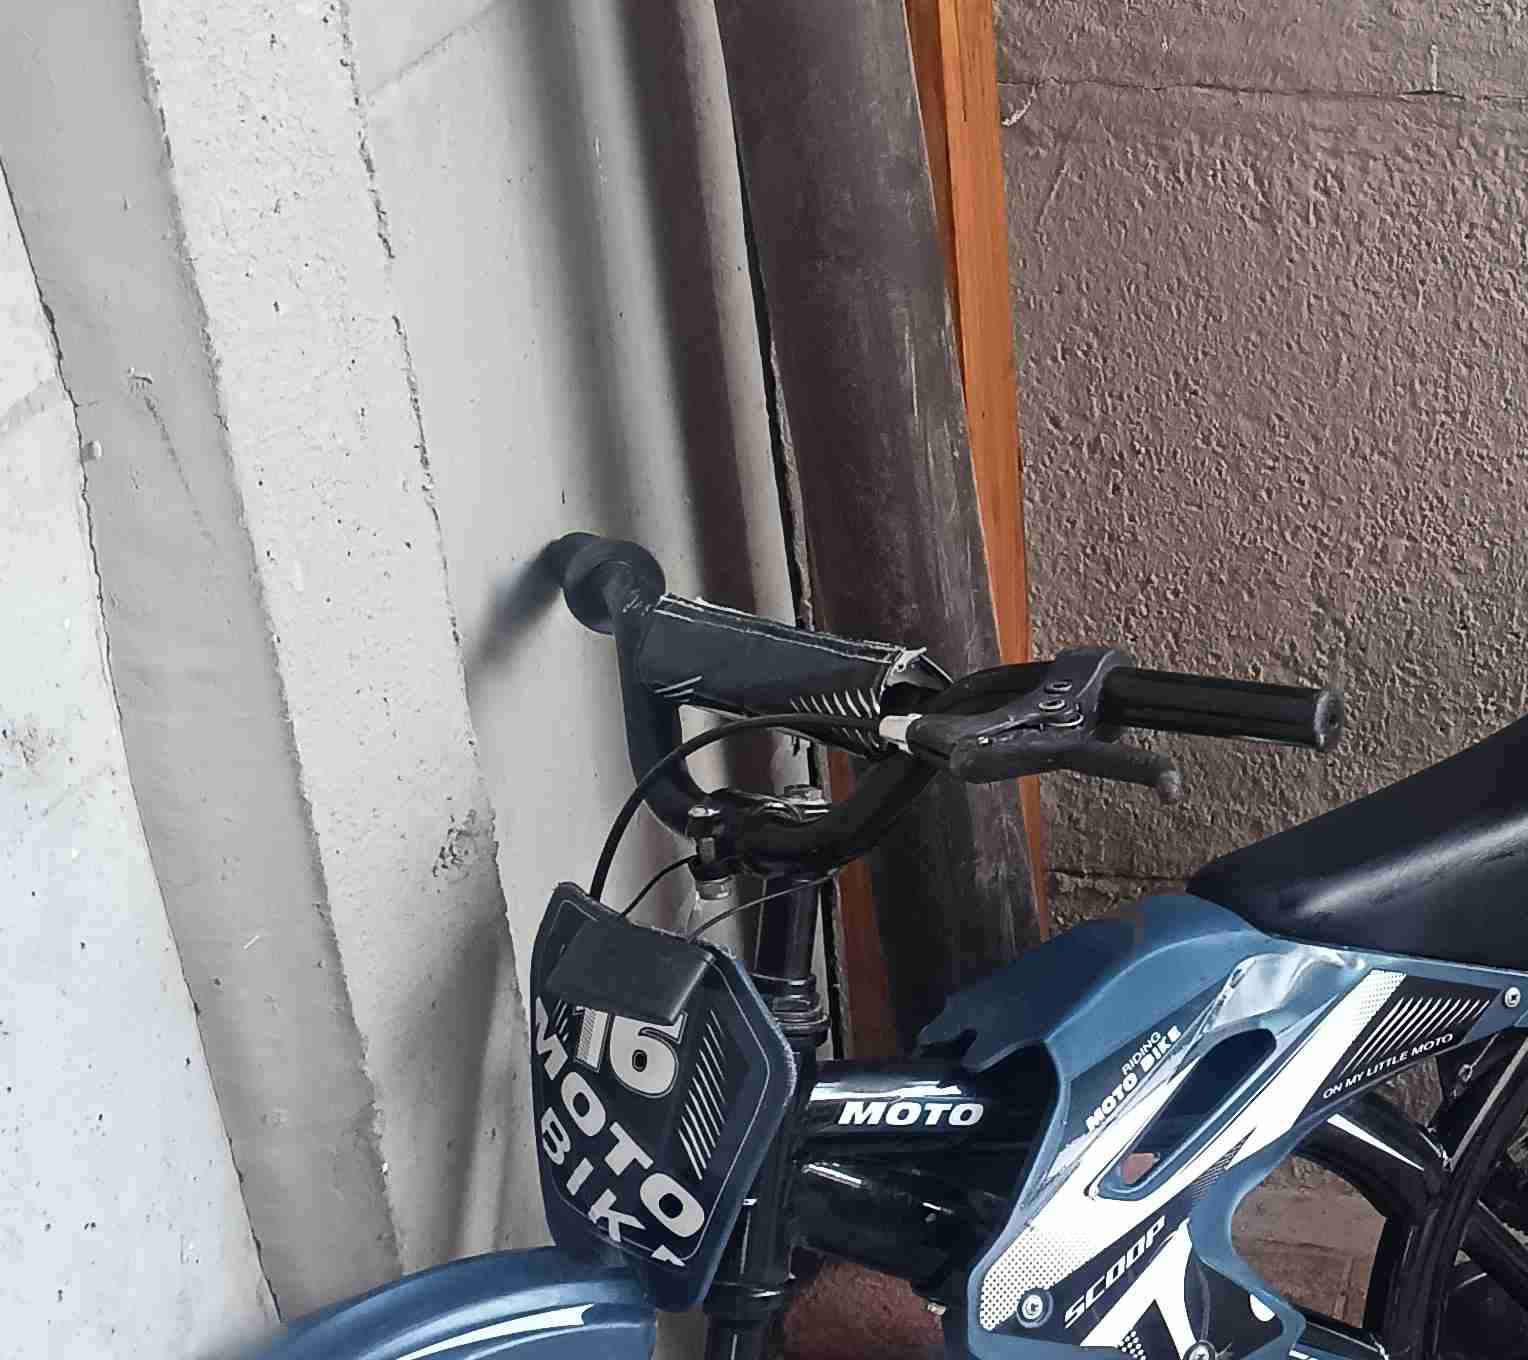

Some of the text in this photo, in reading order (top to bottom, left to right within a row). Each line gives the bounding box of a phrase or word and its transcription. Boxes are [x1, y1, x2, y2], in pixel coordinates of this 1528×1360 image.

[572, 1004, 688, 1100] 16
[1121, 1031, 1162, 1076] RIDING
[1323, 1033, 1453, 1099] ON MY LITTLE MOTO
[535, 996, 706, 1238] MOTO
[838, 1101, 984, 1126] MOTO
[1085, 1072, 1139, 1134] MOTO
[1063, 1215, 1166, 1329] SCOOP
